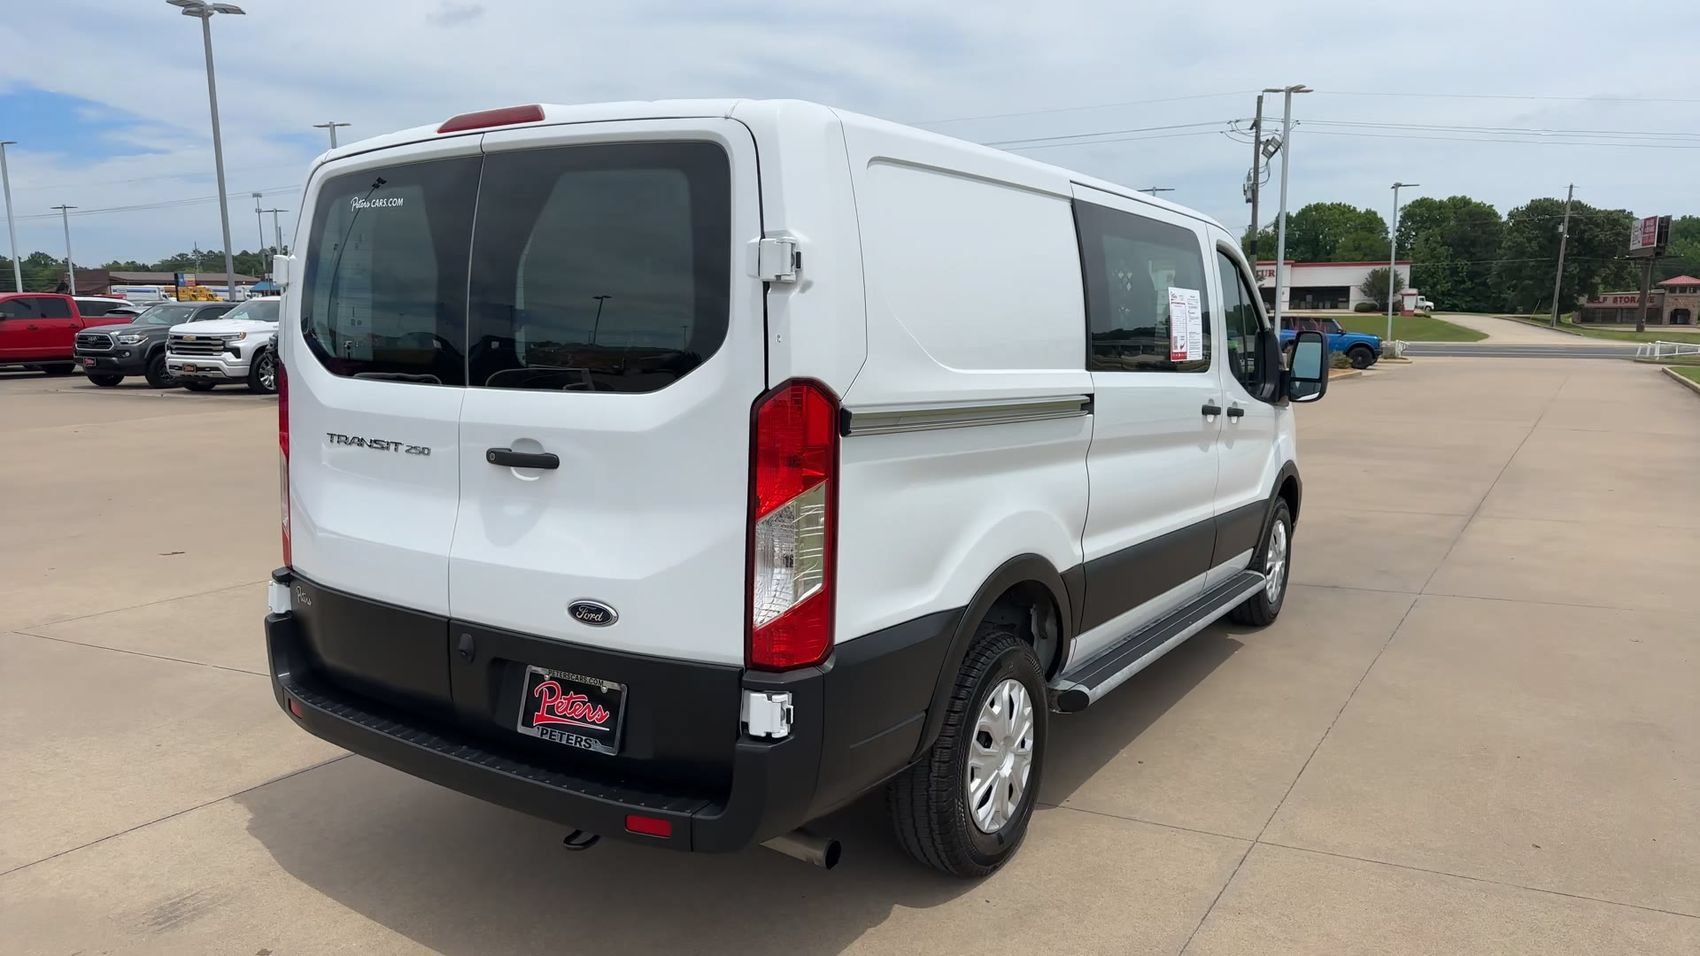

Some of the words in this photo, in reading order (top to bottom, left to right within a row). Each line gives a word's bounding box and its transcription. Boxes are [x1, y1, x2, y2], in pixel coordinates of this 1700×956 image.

[371, 198, 404, 209] CARS.COM
[1612, 296, 1655, 304] STORE
[326, 432, 404, 453] TRANSIT
[404, 445, 431, 457] 250
[576, 605, 603, 622] Ford
[534, 681, 609, 726] Peters
